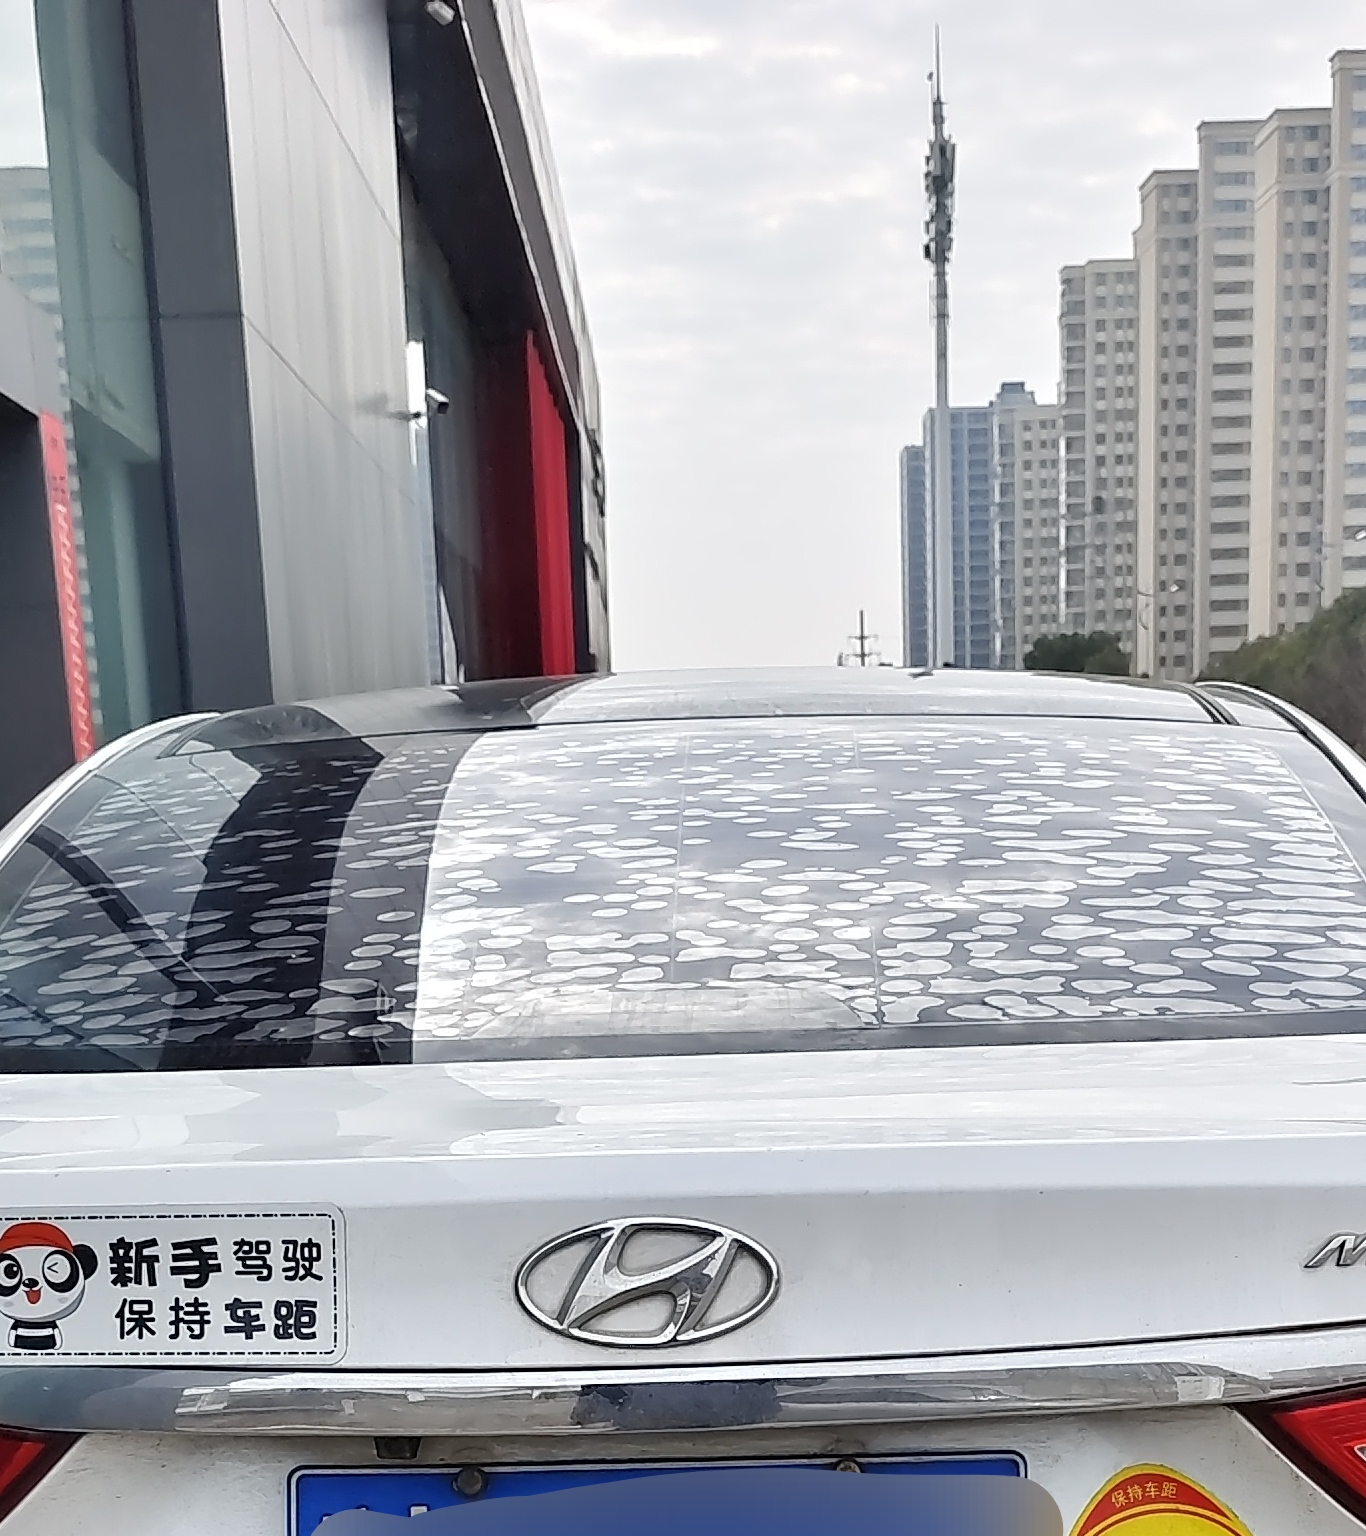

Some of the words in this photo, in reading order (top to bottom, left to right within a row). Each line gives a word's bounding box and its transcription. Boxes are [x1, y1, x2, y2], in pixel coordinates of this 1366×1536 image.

[109, 1237, 323, 1288] 新手驾驶
[115, 1297, 318, 1340] 保持车距
[1111, 1481, 1178, 1508] 保持车距
